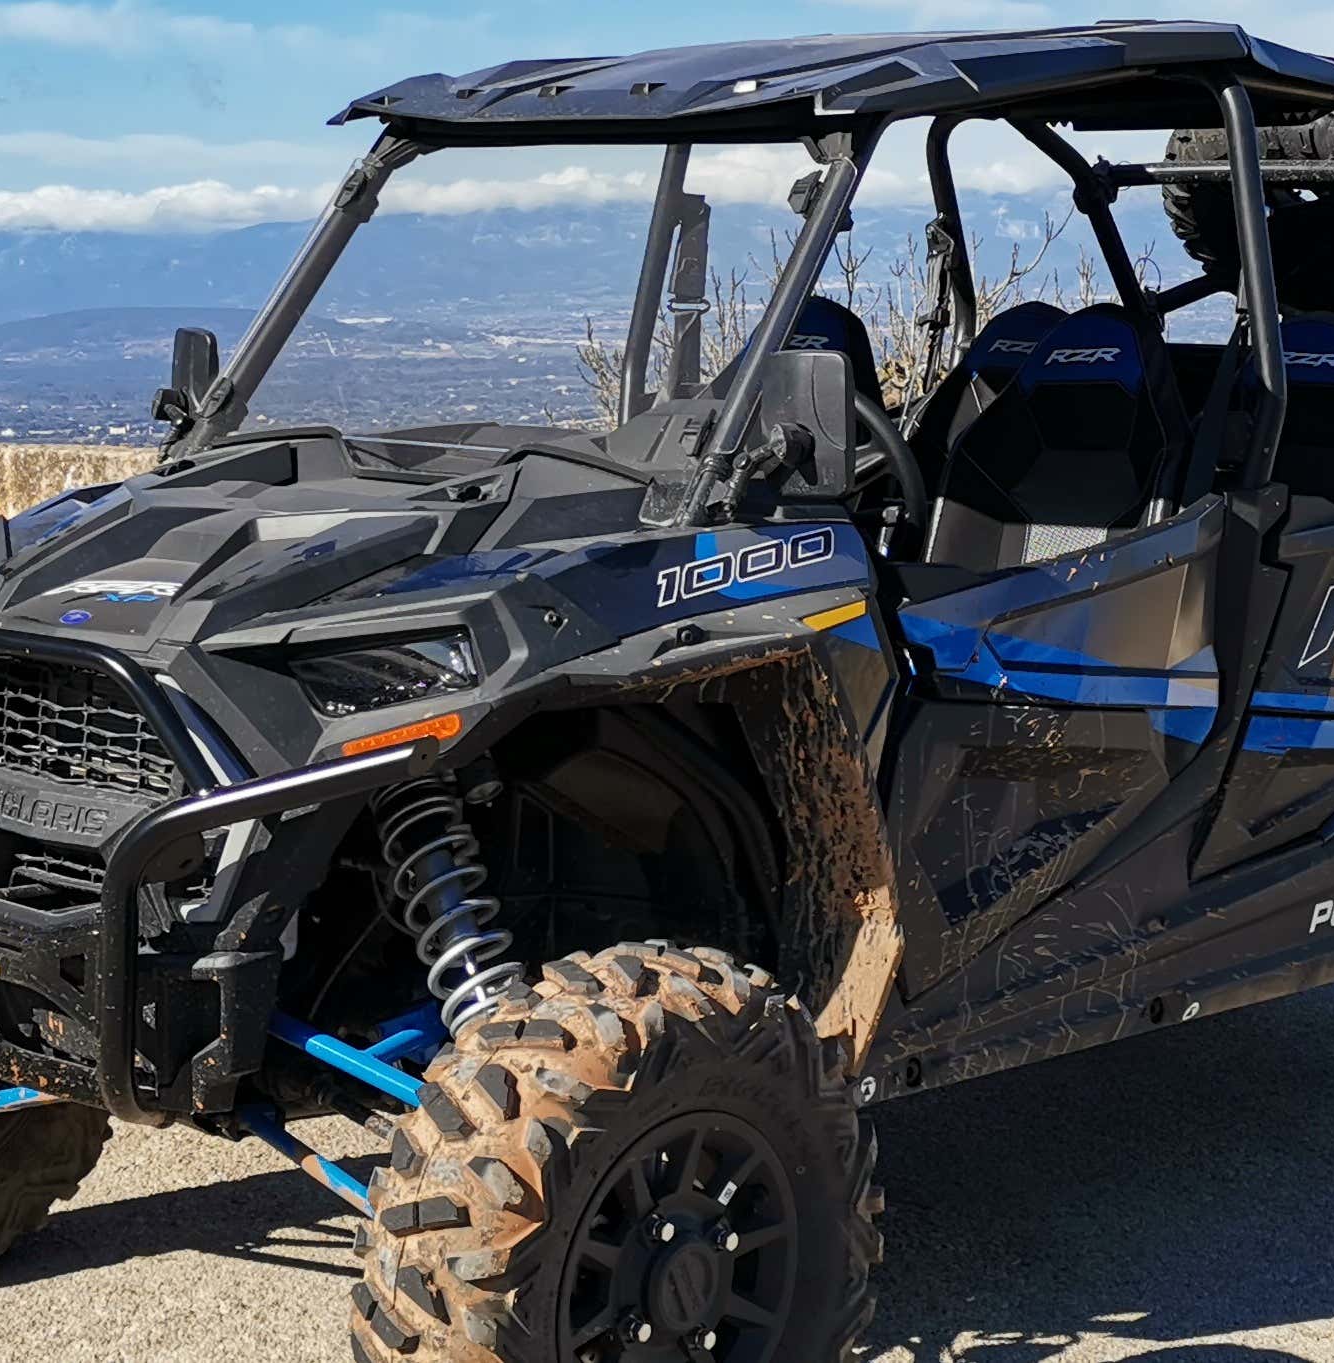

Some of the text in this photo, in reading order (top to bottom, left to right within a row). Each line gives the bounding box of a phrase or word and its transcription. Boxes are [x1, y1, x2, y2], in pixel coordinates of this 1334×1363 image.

[789, 335, 831, 350] ZR
[1044, 347, 1122, 366] RZR
[656, 526, 835, 608] 1000
